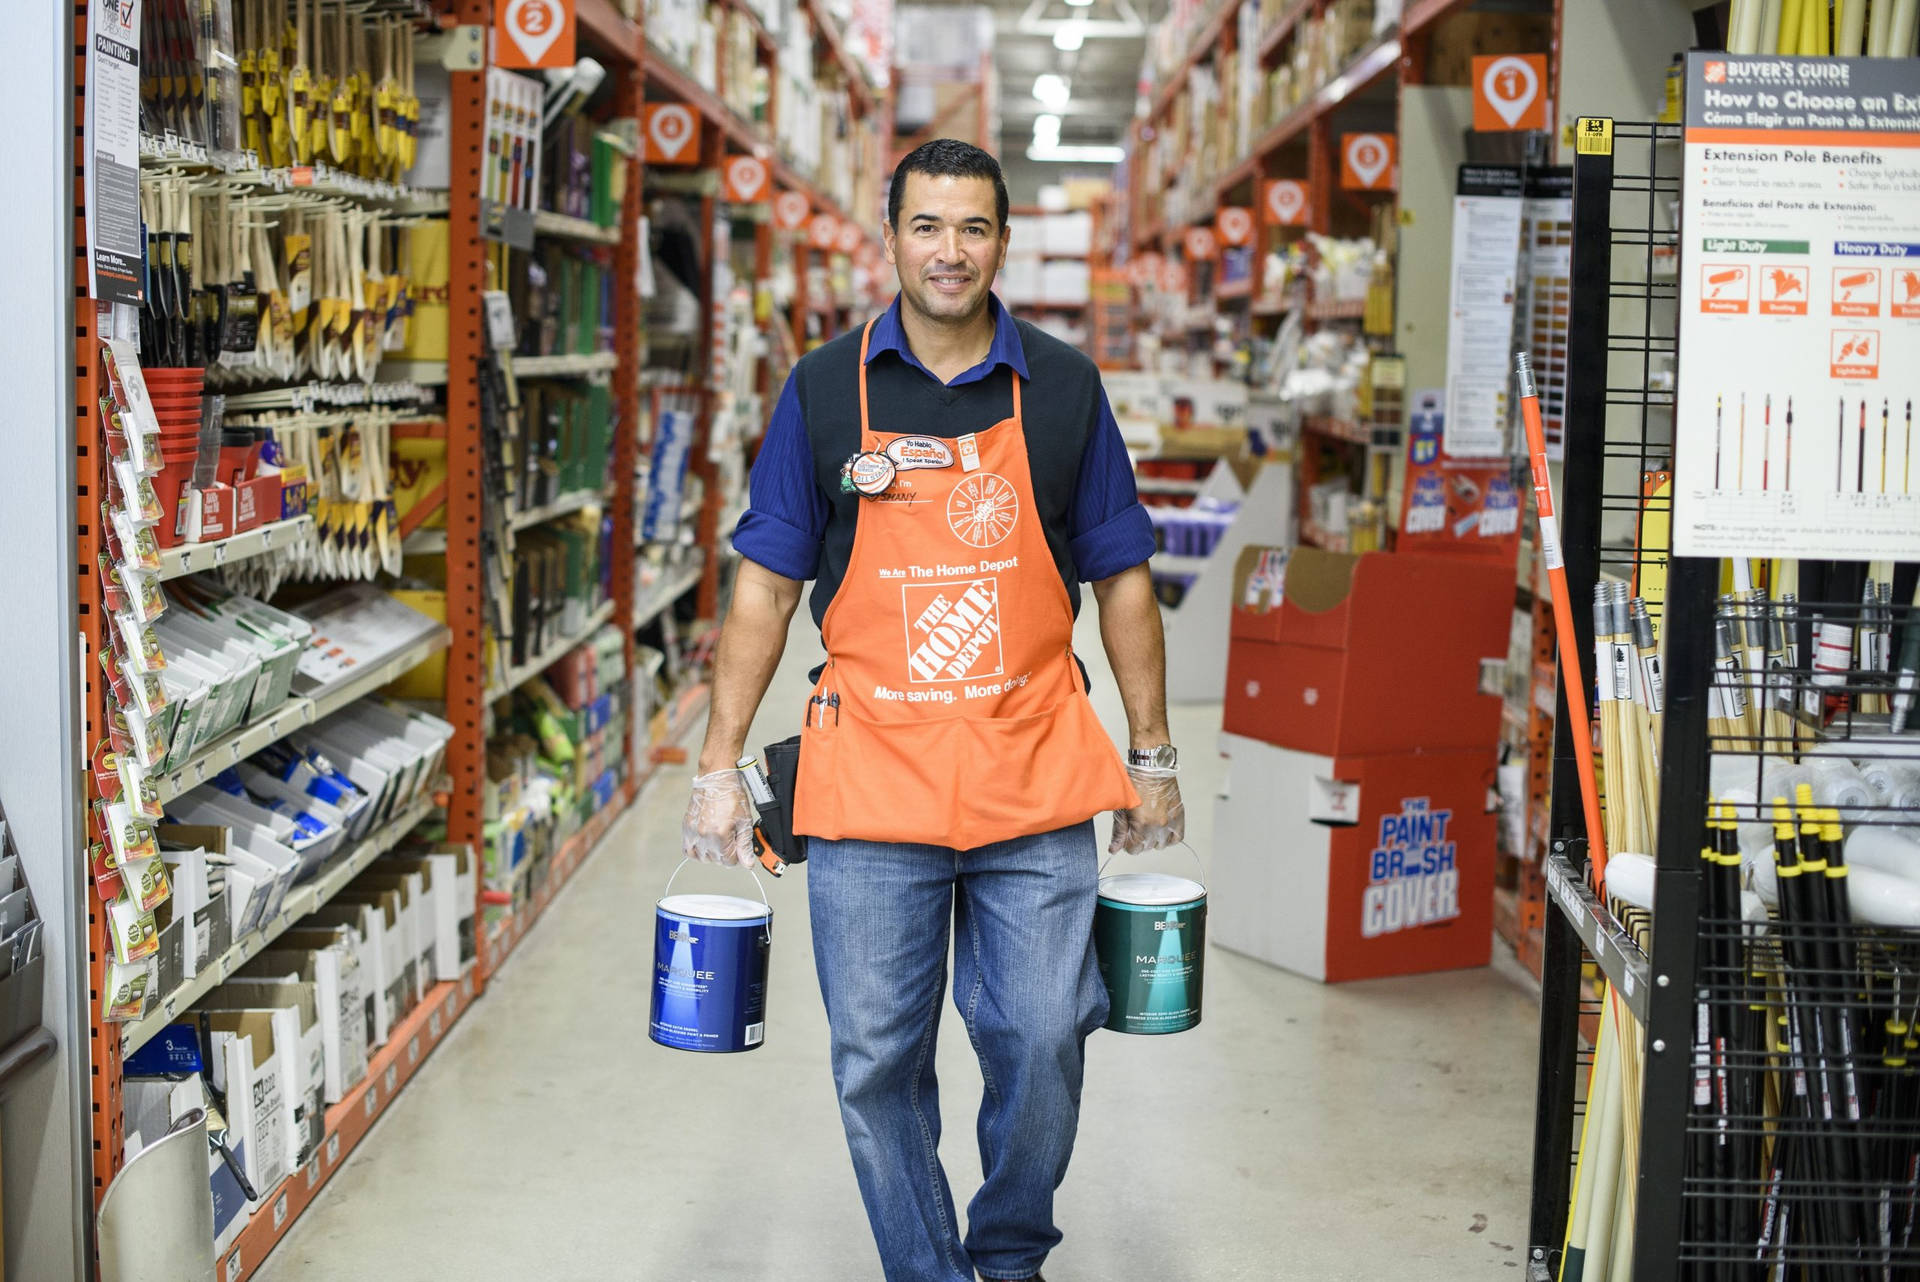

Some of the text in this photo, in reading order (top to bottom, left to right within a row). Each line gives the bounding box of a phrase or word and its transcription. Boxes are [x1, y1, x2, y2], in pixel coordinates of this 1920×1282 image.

[526, 11, 544, 32] 2
[98, 37, 130, 61] PAINTING
[1728, 62, 1850, 79] BUYER'S GUIDE
[1503, 78, 1516, 97] 1
[1704, 90, 1752, 107] How
[1757, 91, 1778, 108] to
[1784, 90, 1856, 111] Choose
[1862, 97, 1888, 111] an
[1704, 112, 1743, 125] Cómo
[1746, 113, 1784, 128] Elegir
[1788, 117, 1804, 126] un
[1808, 114, 1844, 127] Poste
[1848, 115, 1865, 128] de
[1704, 149, 1883, 164] Extension Pole Benefits
[1703, 199, 1754, 208] Beneficios
[1758, 200, 1773, 209] del
[1777, 200, 1803, 210] Poste
[1807, 201, 1820, 210] de
[1707, 240, 1767, 254] Light Duty
[1838, 242, 1908, 257] Heavy Duty
[1709, 303, 1739, 311] Painting
[901, 447, 946, 460] Español
[900, 480, 912, 488] I'm
[879, 556, 1018, 578] We Are The Home Depot
[913, 593, 953, 635] THE
[910, 580, 996, 682] HOME
[946, 614, 999, 680] DEPOT
[874, 686, 905, 700] More
[907, 688, 957, 704] saving.
[964, 684, 1001, 699] More
[1403, 798, 1428, 811] THE
[1382, 811, 1450, 846] PAINT
[1372, 843, 1455, 880] BRSH
[1362, 869, 1459, 938] COVER
[1136, 951, 1197, 965] MARQUEE
[166, 1040, 174, 1051] 3
[264, 1073, 276, 1096] 222
[257, 1120, 269, 1142] 222
